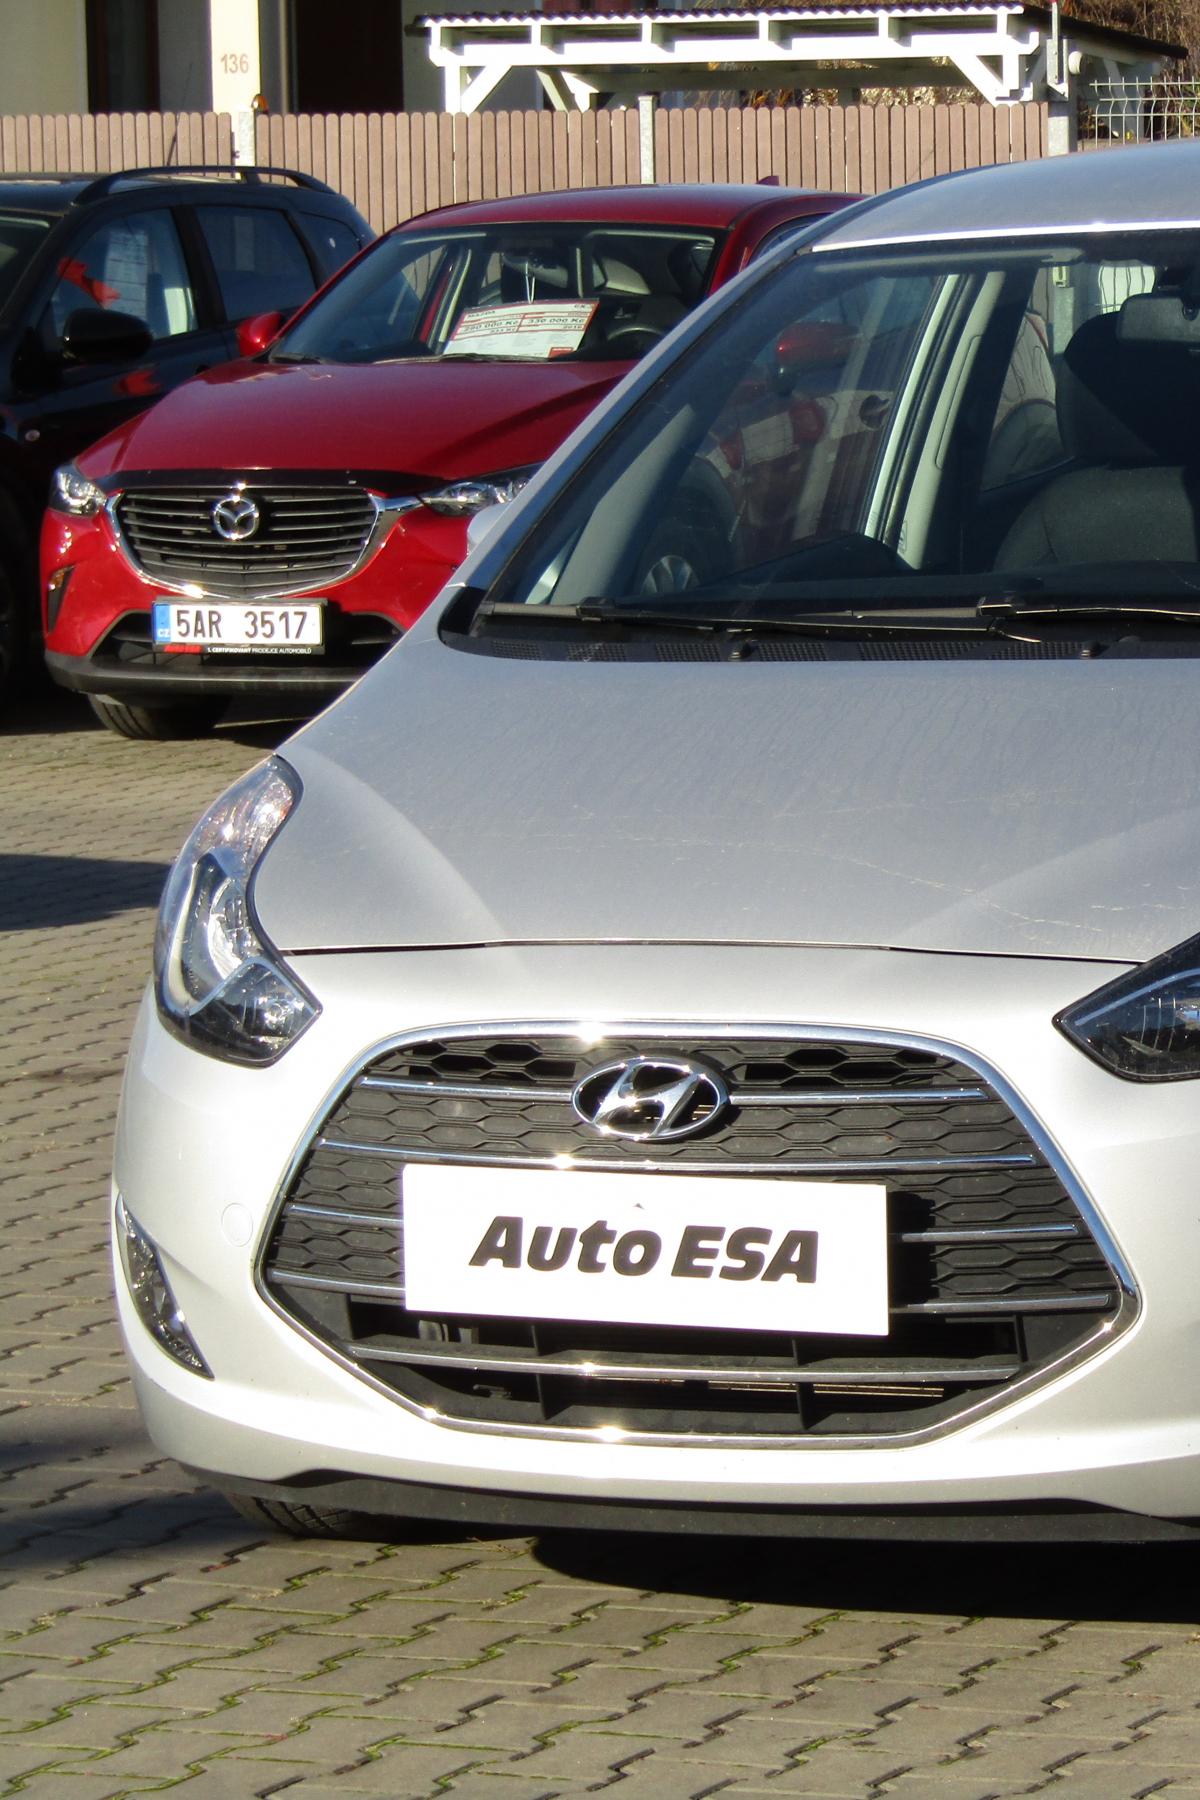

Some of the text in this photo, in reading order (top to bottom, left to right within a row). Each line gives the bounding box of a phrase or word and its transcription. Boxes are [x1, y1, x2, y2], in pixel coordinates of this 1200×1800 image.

[221, 53, 249, 74] 136
[158, 628, 170, 638] CZ
[176, 610, 308, 639] 5AR 3517
[468, 1215, 819, 1284] Auto ESA
